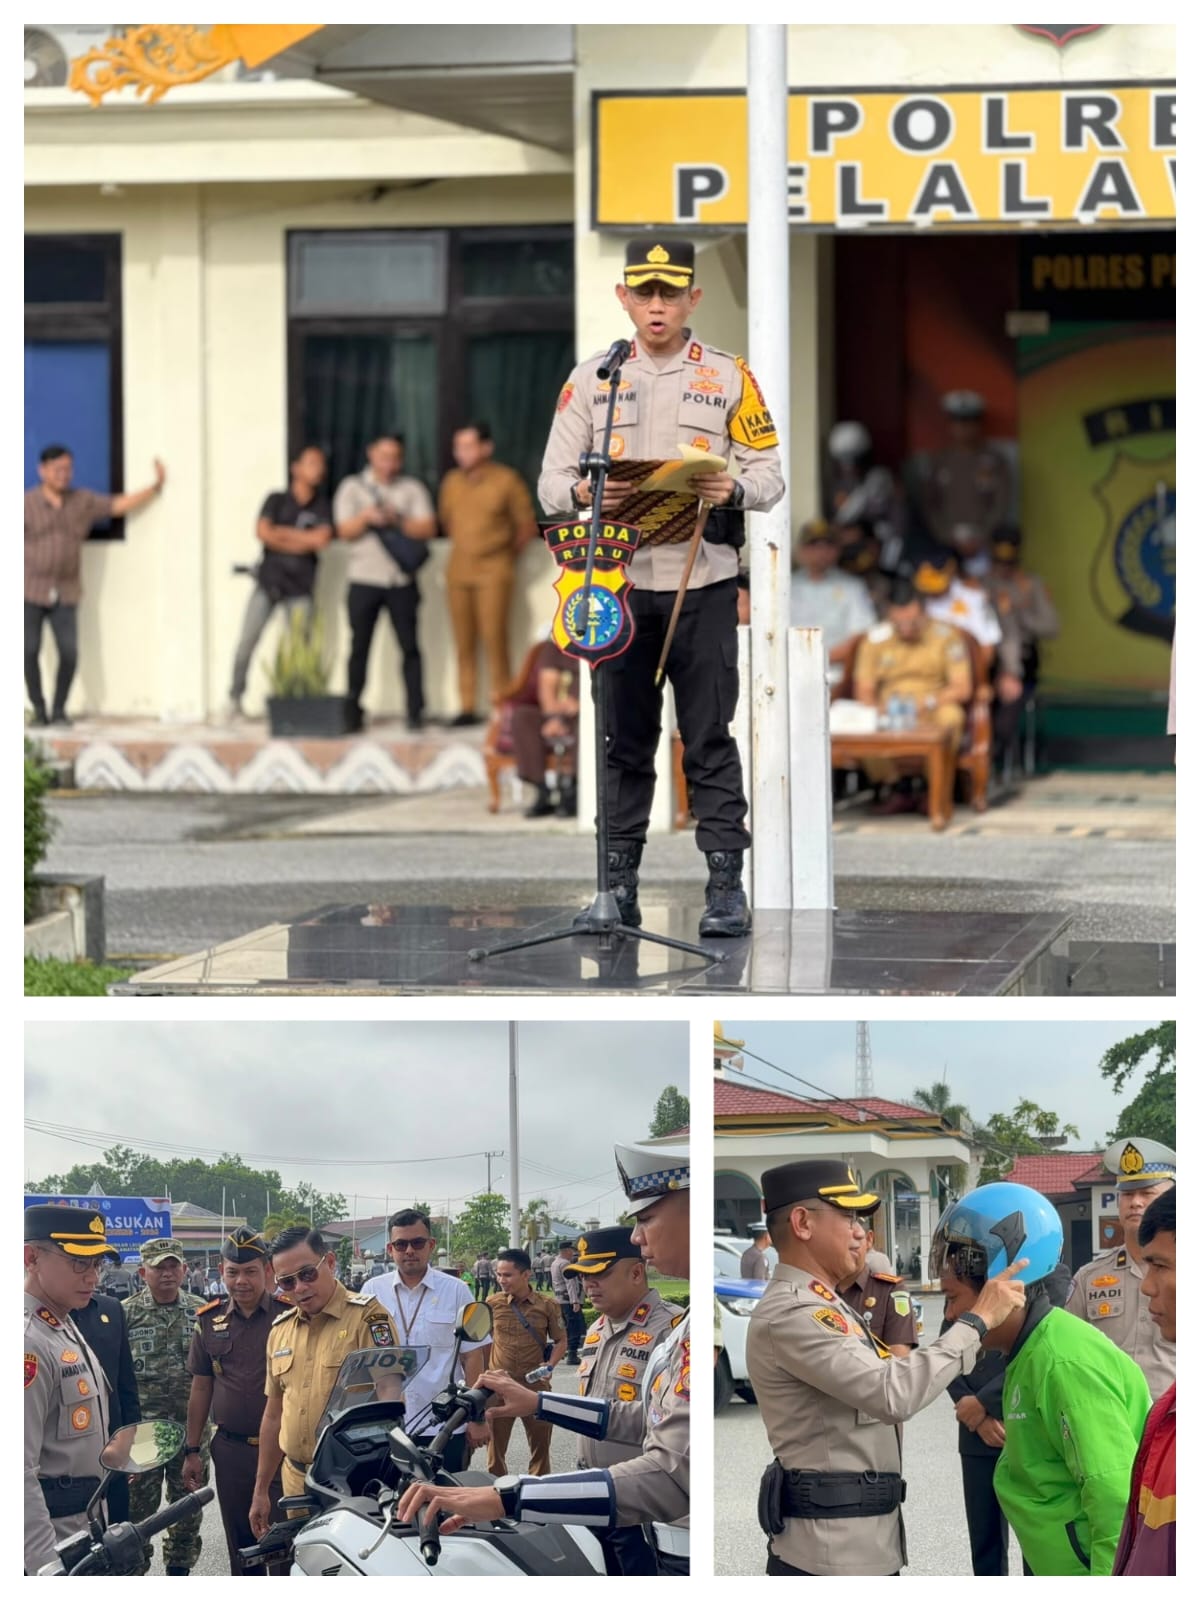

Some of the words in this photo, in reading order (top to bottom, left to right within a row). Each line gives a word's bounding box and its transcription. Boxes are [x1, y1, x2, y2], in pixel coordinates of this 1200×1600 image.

[678, 158, 1176, 218] PLALA
[1032, 256, 1144, 290] POLRES
[1152, 255, 1176, 289] P
[683, 392, 727, 409] POLRI
[563, 547, 622, 560] RIAU
[1089, 1289, 1121, 1300] HADI
[620, 1347, 649, 1360] POLRI
